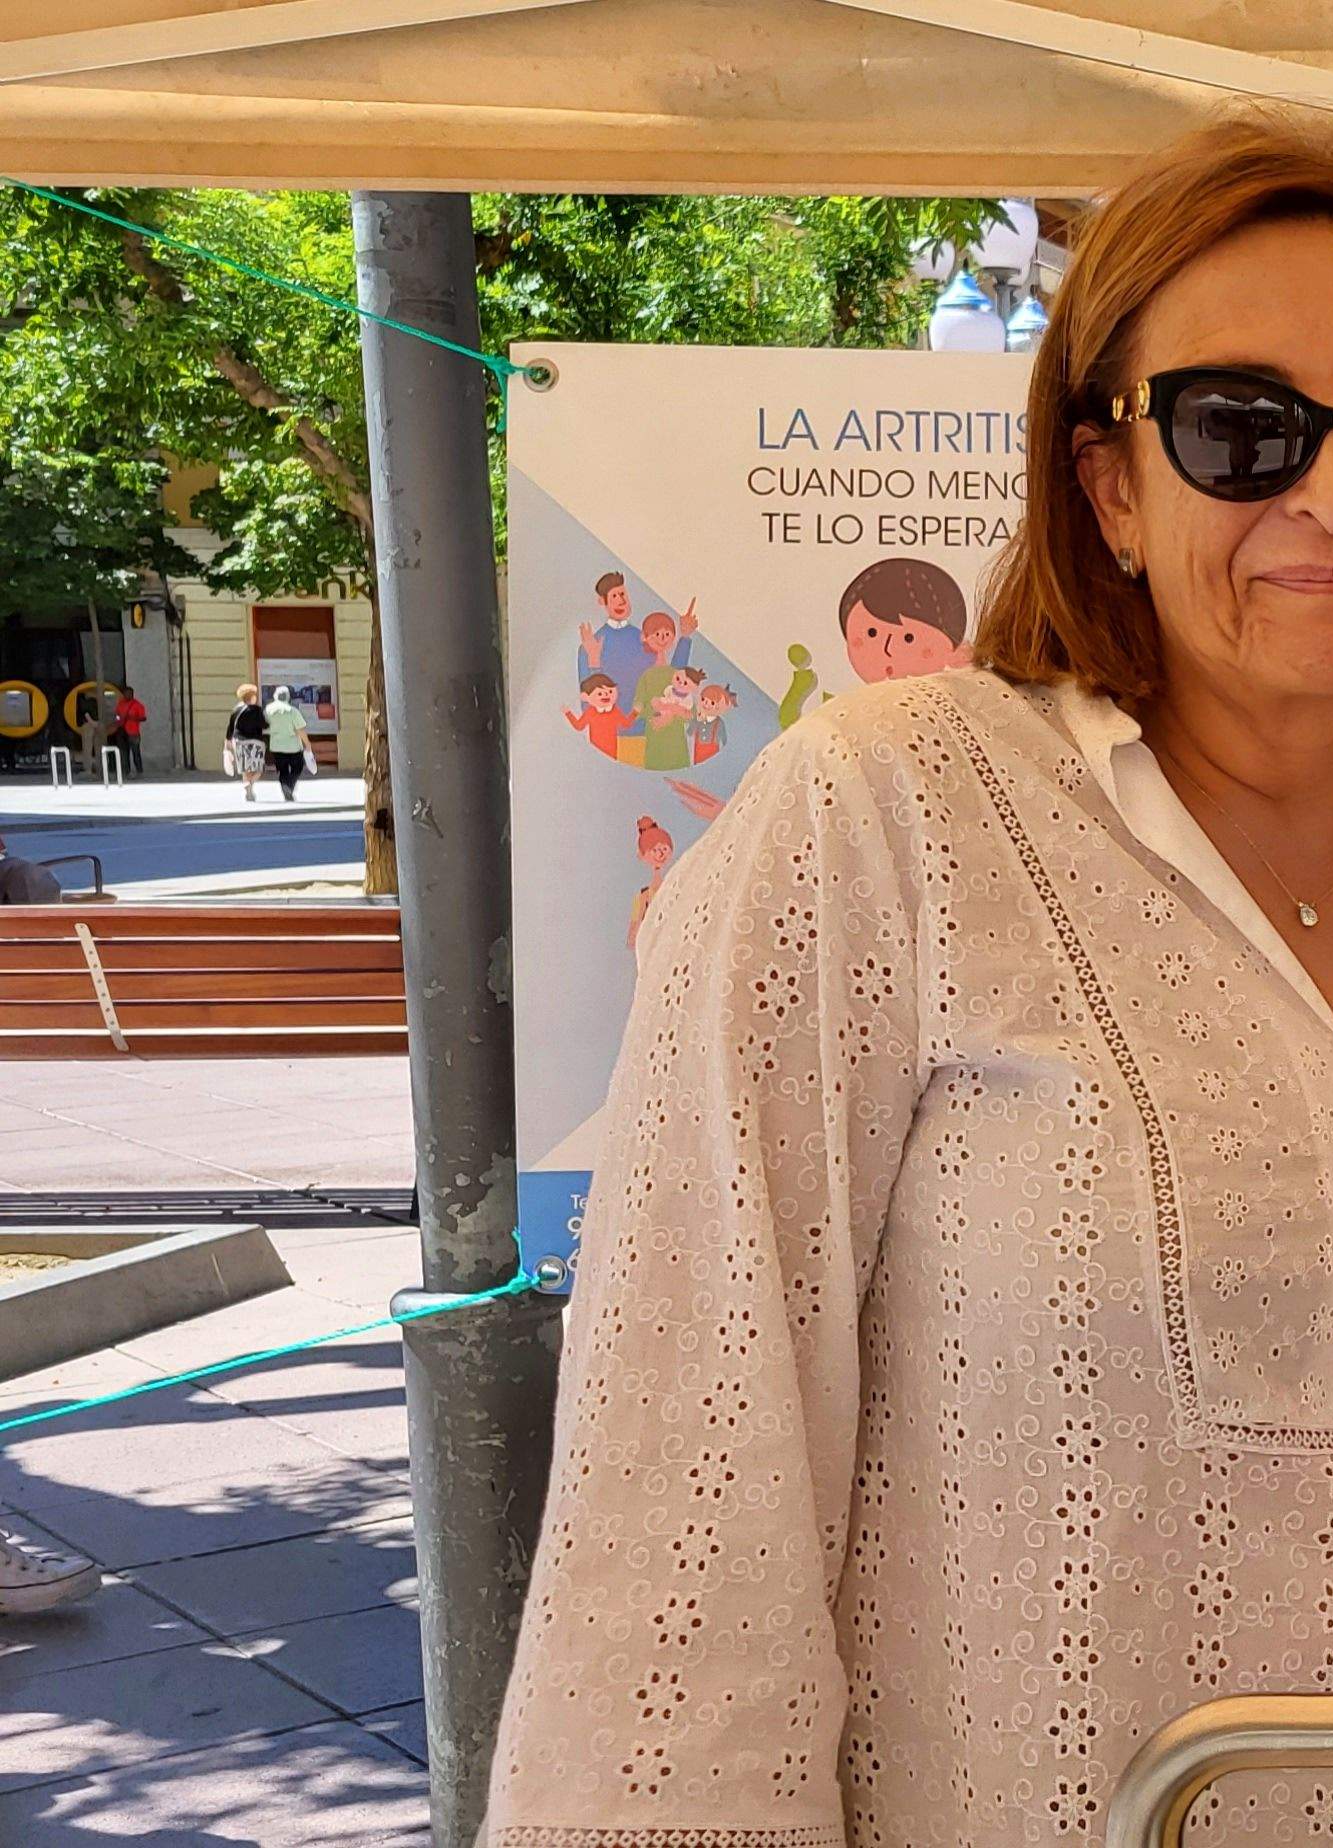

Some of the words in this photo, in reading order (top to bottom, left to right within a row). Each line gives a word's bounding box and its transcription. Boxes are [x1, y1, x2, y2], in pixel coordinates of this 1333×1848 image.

[758, 407, 820, 451] LA
[747, 466, 915, 498] CUANDO
[928, 470, 1028, 501] MENO
[761, 512, 801, 544] TE
[816, 513, 864, 545] LO
[878, 514, 1012, 548] ESPERA
